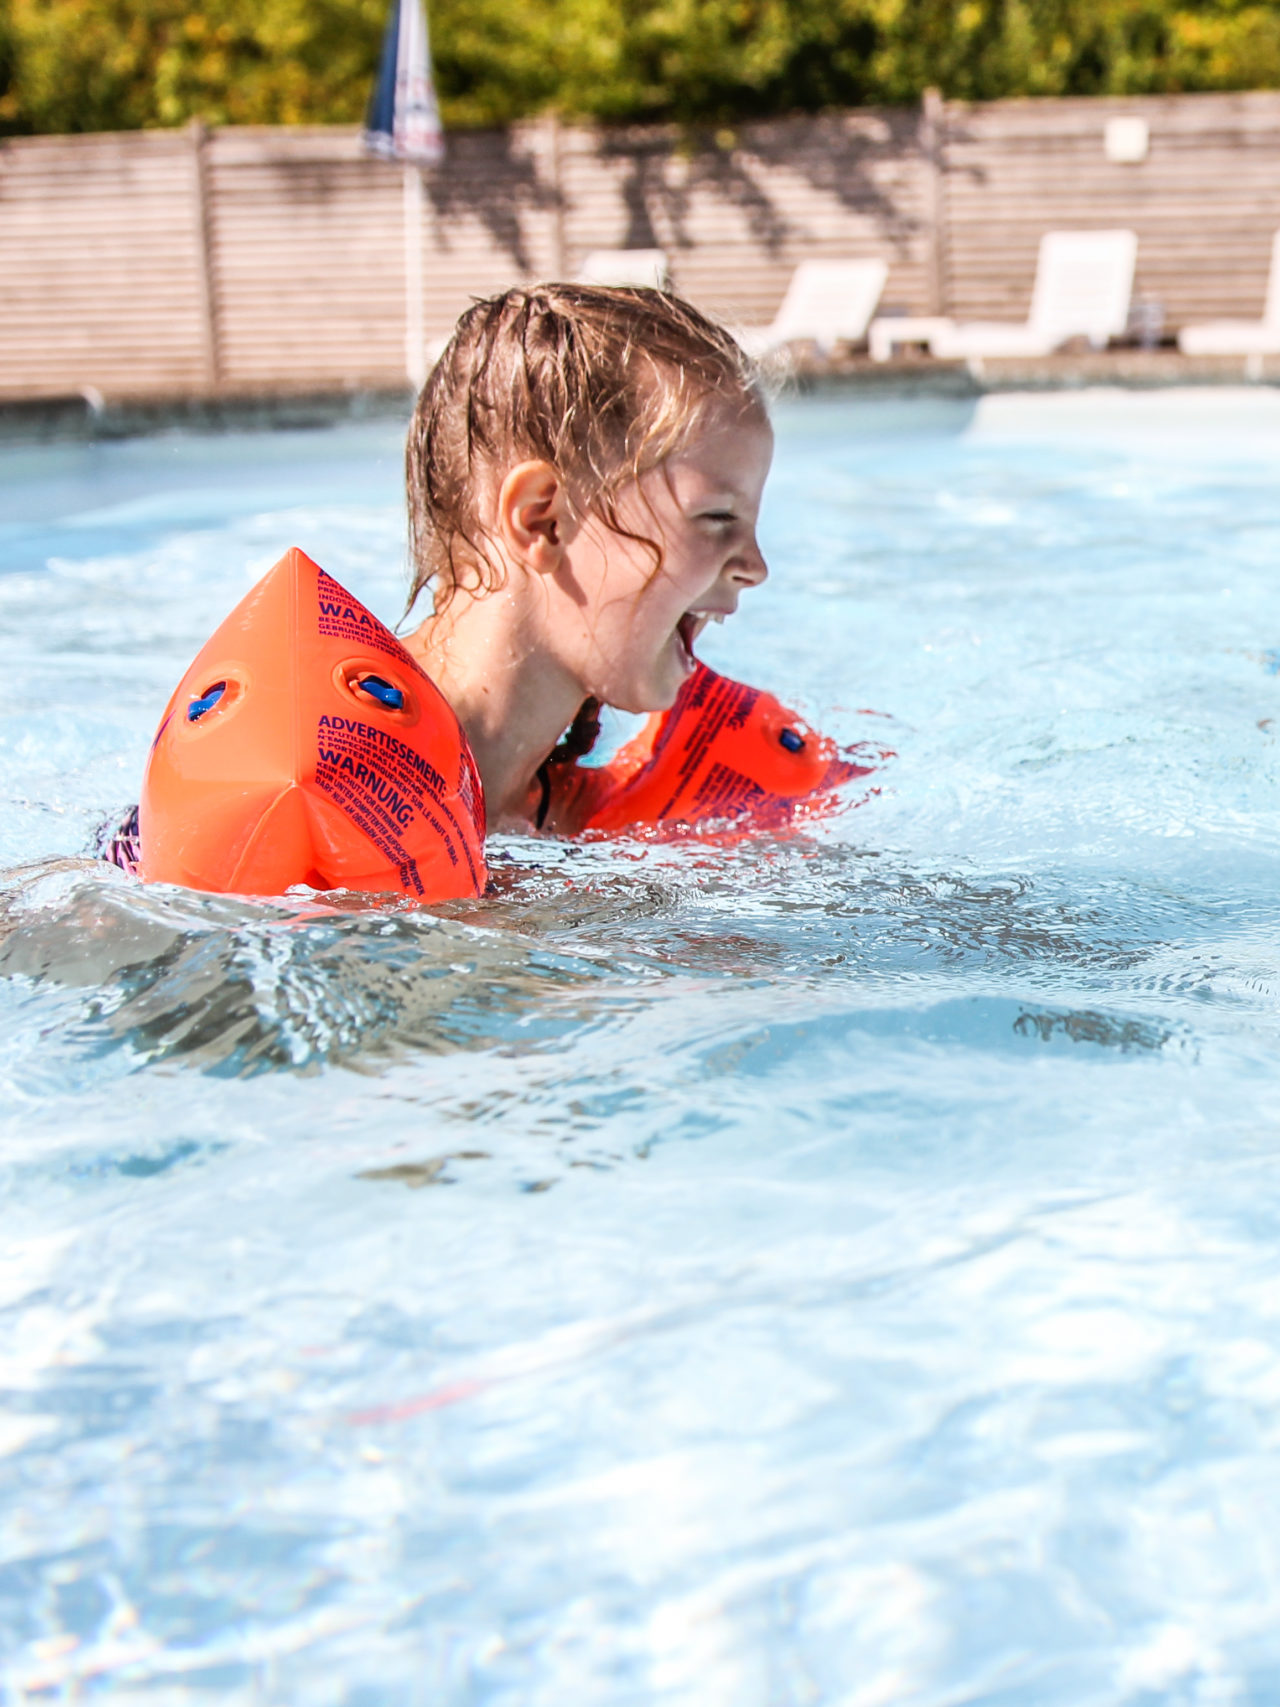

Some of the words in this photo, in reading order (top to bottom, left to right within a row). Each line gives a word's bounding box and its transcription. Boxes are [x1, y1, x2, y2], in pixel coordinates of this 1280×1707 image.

[318, 623, 372, 641] GEBRUIKEN
[318, 629, 340, 638] MAG
[316, 761, 338, 775] KEIN
[338, 771, 366, 797] SCHUTZ
[363, 792, 377, 808] VOR
[318, 715, 446, 798] ADVERTISSEMENT:
[372, 752, 387, 766] PAS
[388, 763, 398, 774] LA
[379, 748, 396, 763] QUE
[397, 759, 415, 778] SOUS
[415, 774, 454, 822] SURVEILLANCE
[315, 775, 334, 793] DARF
[331, 791, 346, 806] NUR
[316, 768, 334, 783] NUR
[333, 779, 354, 800] UNTER
[352, 797, 389, 836] KOMPETENTER
[385, 834, 411, 861] AUFSICHT
[318, 747, 415, 829] WARNUNG:
[327, 742, 365, 762] PORTER
[366, 757, 412, 798] UNIQUEMENT
[411, 794, 424, 810] SUR
[422, 807, 432, 820] LE
[430, 816, 446, 836] HAUT
